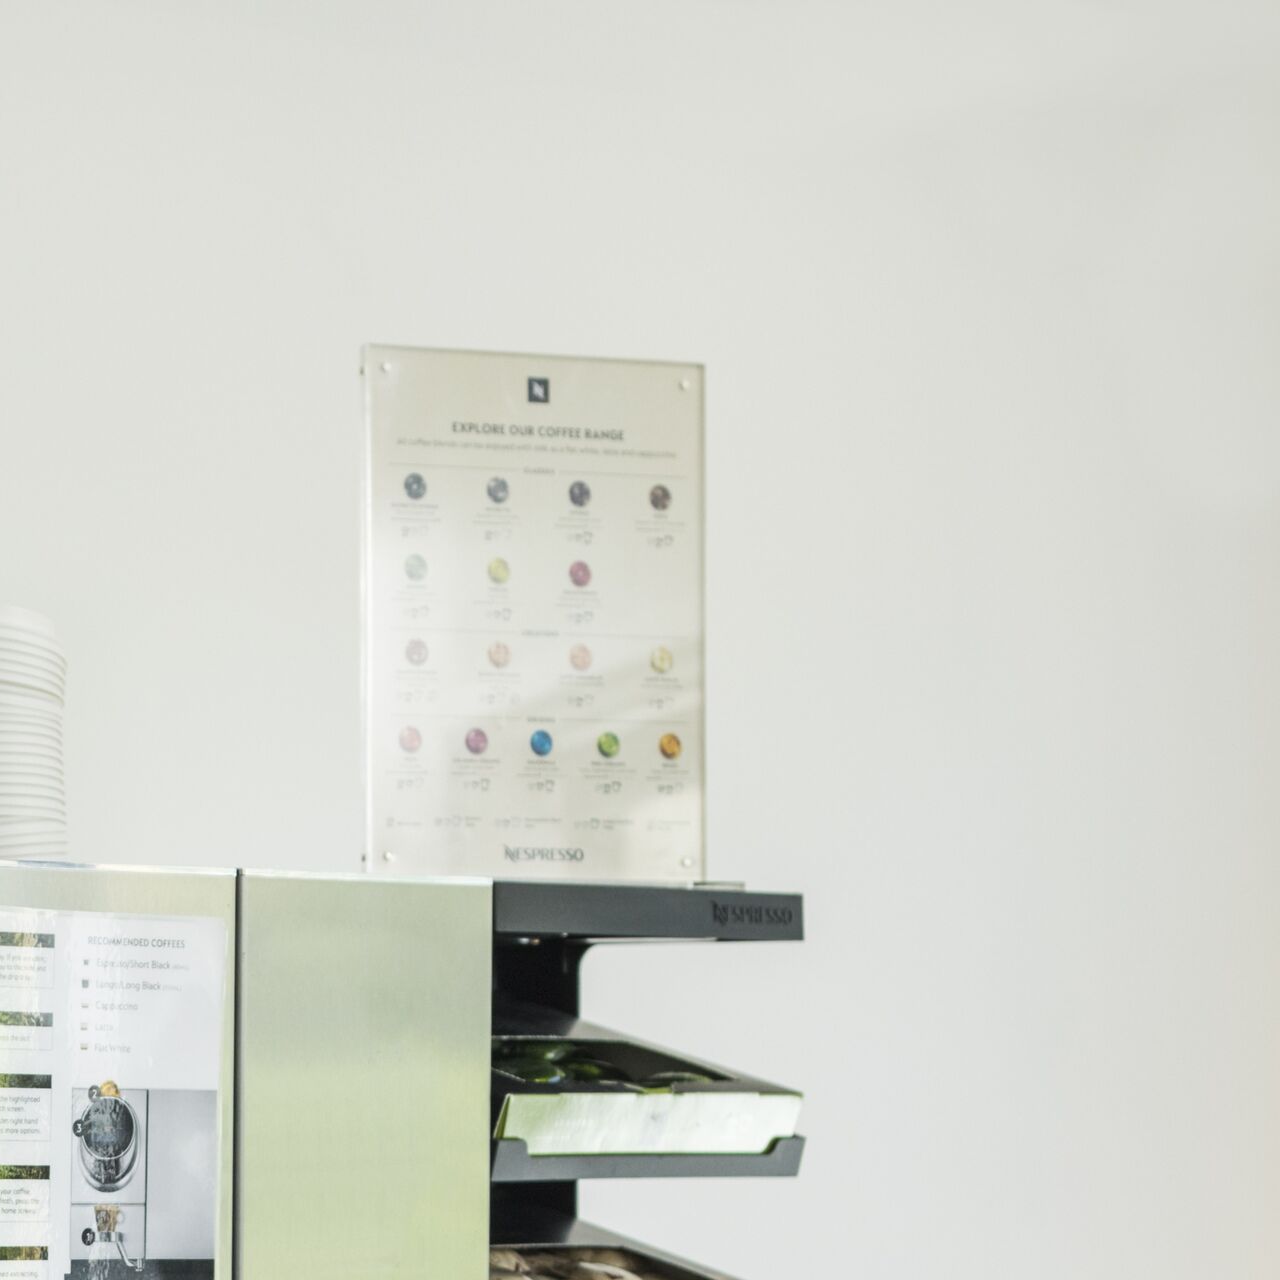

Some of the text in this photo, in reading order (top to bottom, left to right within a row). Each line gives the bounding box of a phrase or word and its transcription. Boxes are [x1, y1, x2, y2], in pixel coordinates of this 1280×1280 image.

[452, 421, 625, 442] EXPLORE OUR COFFEE RANGE
[504, 845, 584, 863] NESPRESSO
[151, 938, 185, 949] COFFEES
[151, 960, 170, 970] Black
[142, 980, 161, 991] Black
